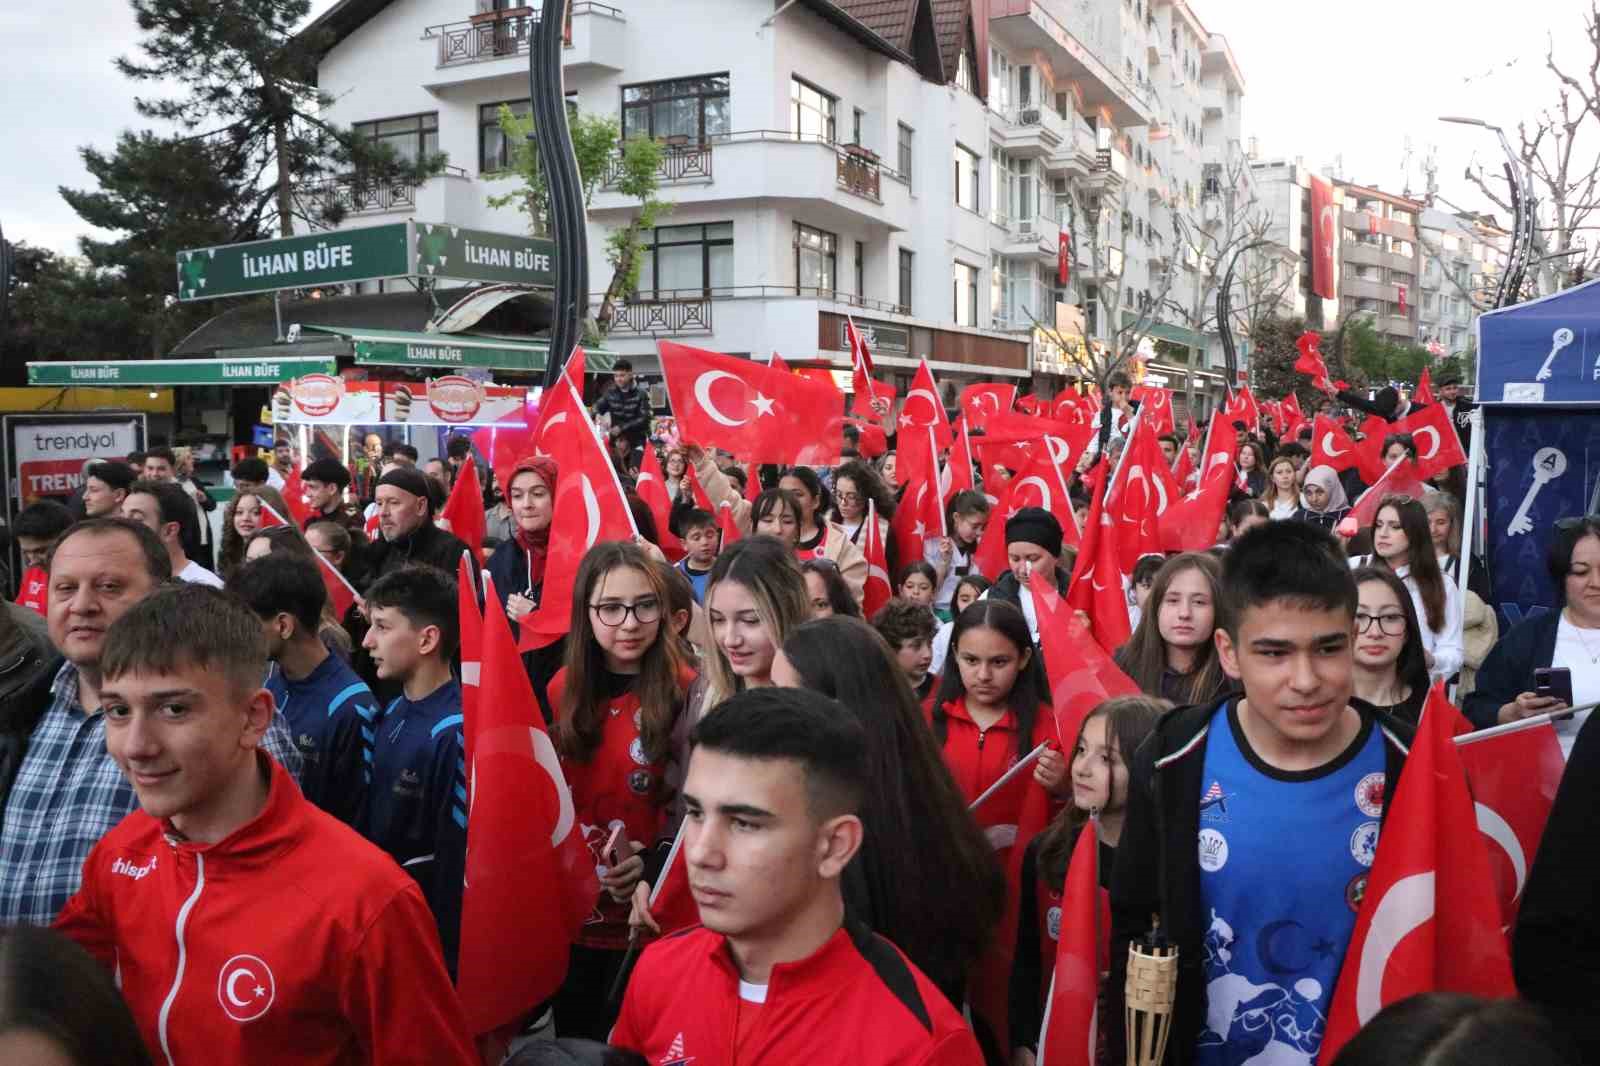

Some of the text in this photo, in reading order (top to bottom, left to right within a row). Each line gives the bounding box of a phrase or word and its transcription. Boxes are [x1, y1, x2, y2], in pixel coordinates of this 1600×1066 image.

[242, 242, 353, 278] İLHAN BÜFE
[464, 240, 550, 272] İLHAN BÜFE
[407, 343, 462, 361] İLHAN BÜFE
[71, 365, 120, 379] İLHAN BÜFE
[222, 362, 280, 377] İLHAN BÜFE
[34, 432, 115, 452] trendyol
